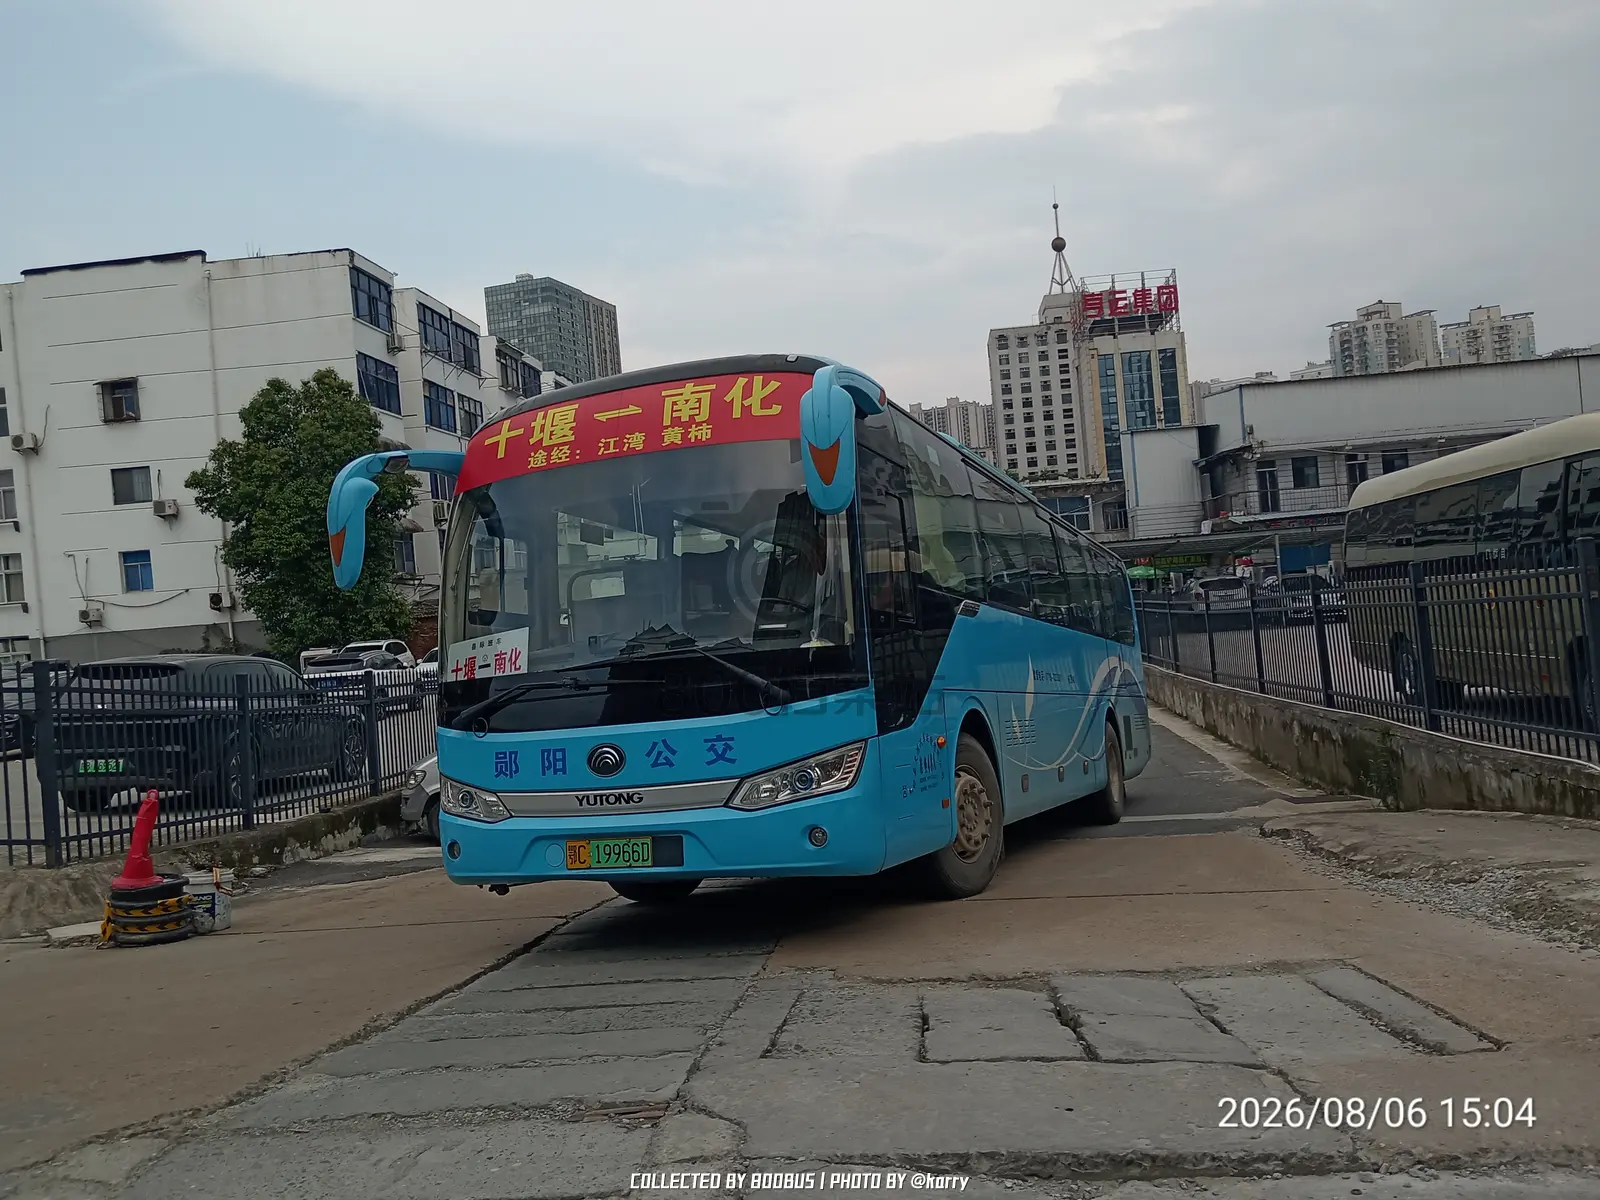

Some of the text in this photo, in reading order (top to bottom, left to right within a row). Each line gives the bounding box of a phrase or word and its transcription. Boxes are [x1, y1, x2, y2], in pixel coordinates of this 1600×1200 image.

[484, 375, 783, 460] 十堰 南化
[597, 432, 647, 456] 江湾
[661, 422, 713, 447] 黄柿
[493, 733, 738, 780] 郧阳 公交
[574, 792, 644, 807] YUTONG
